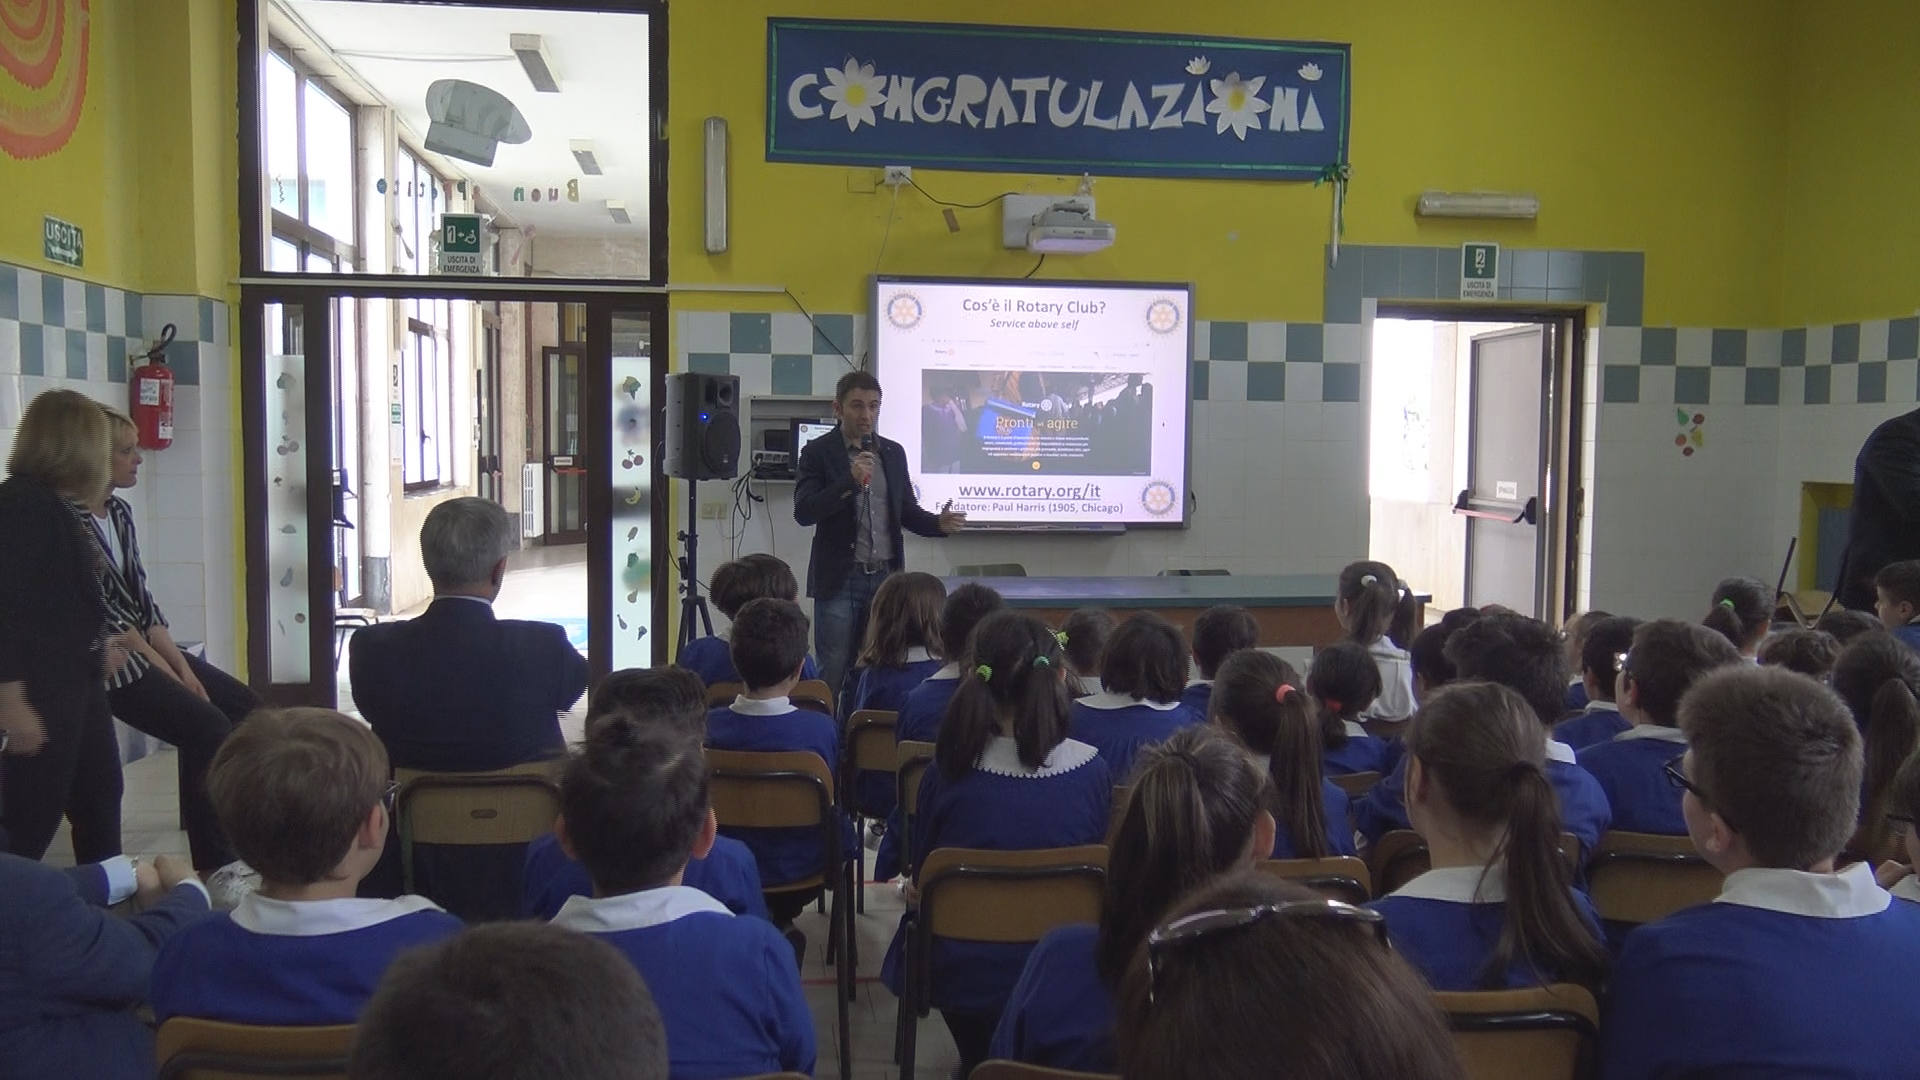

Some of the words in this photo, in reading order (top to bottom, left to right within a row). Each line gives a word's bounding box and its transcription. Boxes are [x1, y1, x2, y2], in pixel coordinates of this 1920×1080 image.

[45, 221, 83, 249] USCITA
[1477, 252, 1484, 265] 2
[443, 265, 480, 273] EMERGENZA
[1466, 281, 1486, 289] USCITA
[1485, 281, 1491, 289] DI
[1462, 290, 1494, 298] EMERGENZA
[962, 298, 1000, 312] Cos'è
[1003, 299, 1012, 313] il
[1016, 300, 1063, 316] Rotary
[1067, 300, 1106, 315] Club?
[990, 318, 1025, 328] Service
[1027, 319, 1057, 329] above
[1061, 319, 1080, 331] self
[1021, 401, 1040, 409] Rotary
[995, 416, 1034, 429] Pronti
[1047, 418, 1079, 432] agire
[958, 483, 1101, 500] www.rotary.org/it
[992, 502, 1013, 512] Paul
[1016, 502, 1045, 512] Harris
[1049, 503, 1078, 514] (1905,
[1081, 503, 1124, 515] Chicago)
